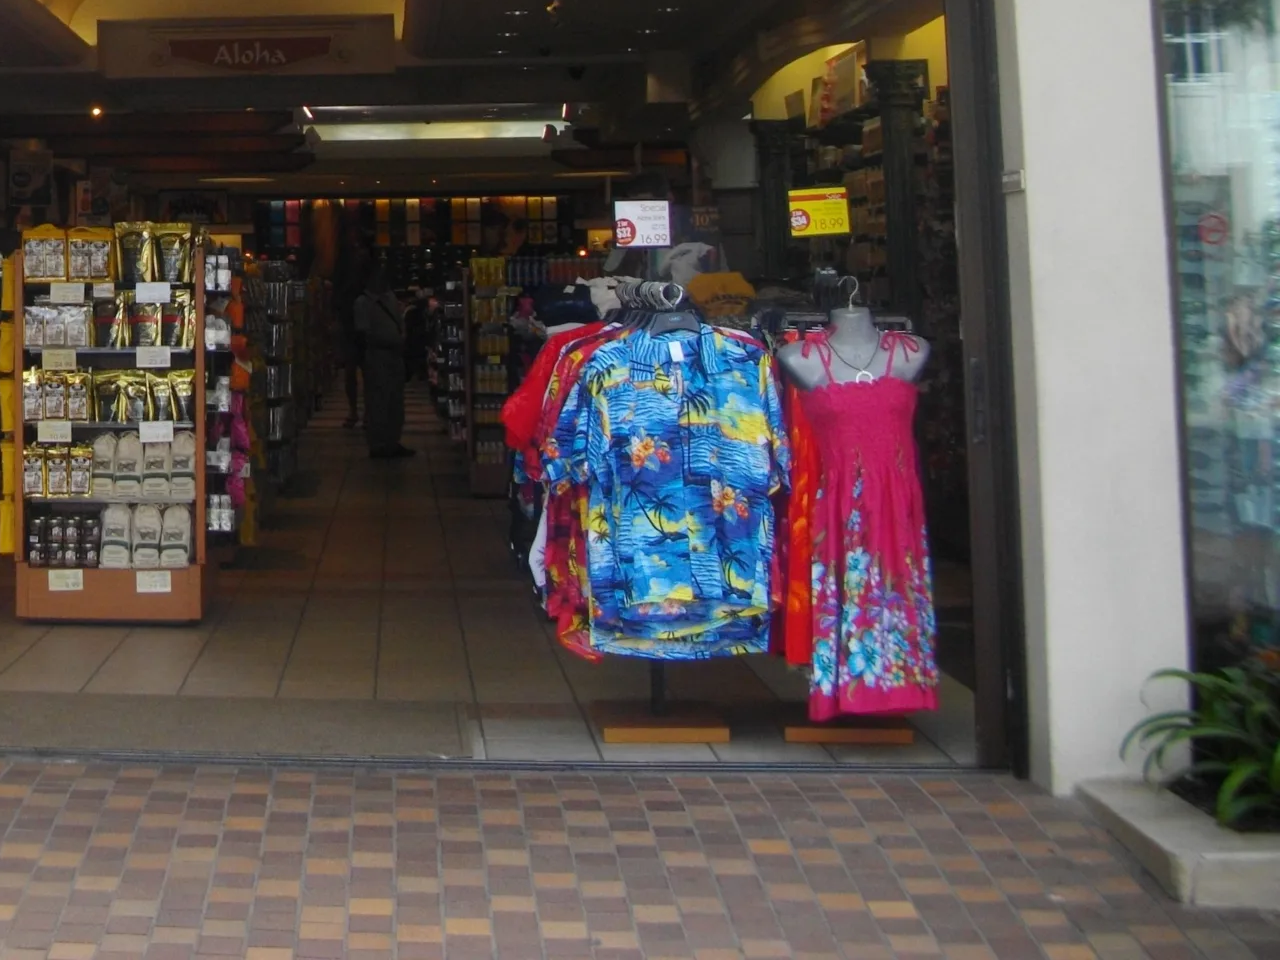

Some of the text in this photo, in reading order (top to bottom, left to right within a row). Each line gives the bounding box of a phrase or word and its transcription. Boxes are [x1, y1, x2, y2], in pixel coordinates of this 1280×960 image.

[213, 41, 287, 65] Aloha
[813, 218, 844, 230] 18.99
[640, 233, 668, 245] 16.99
